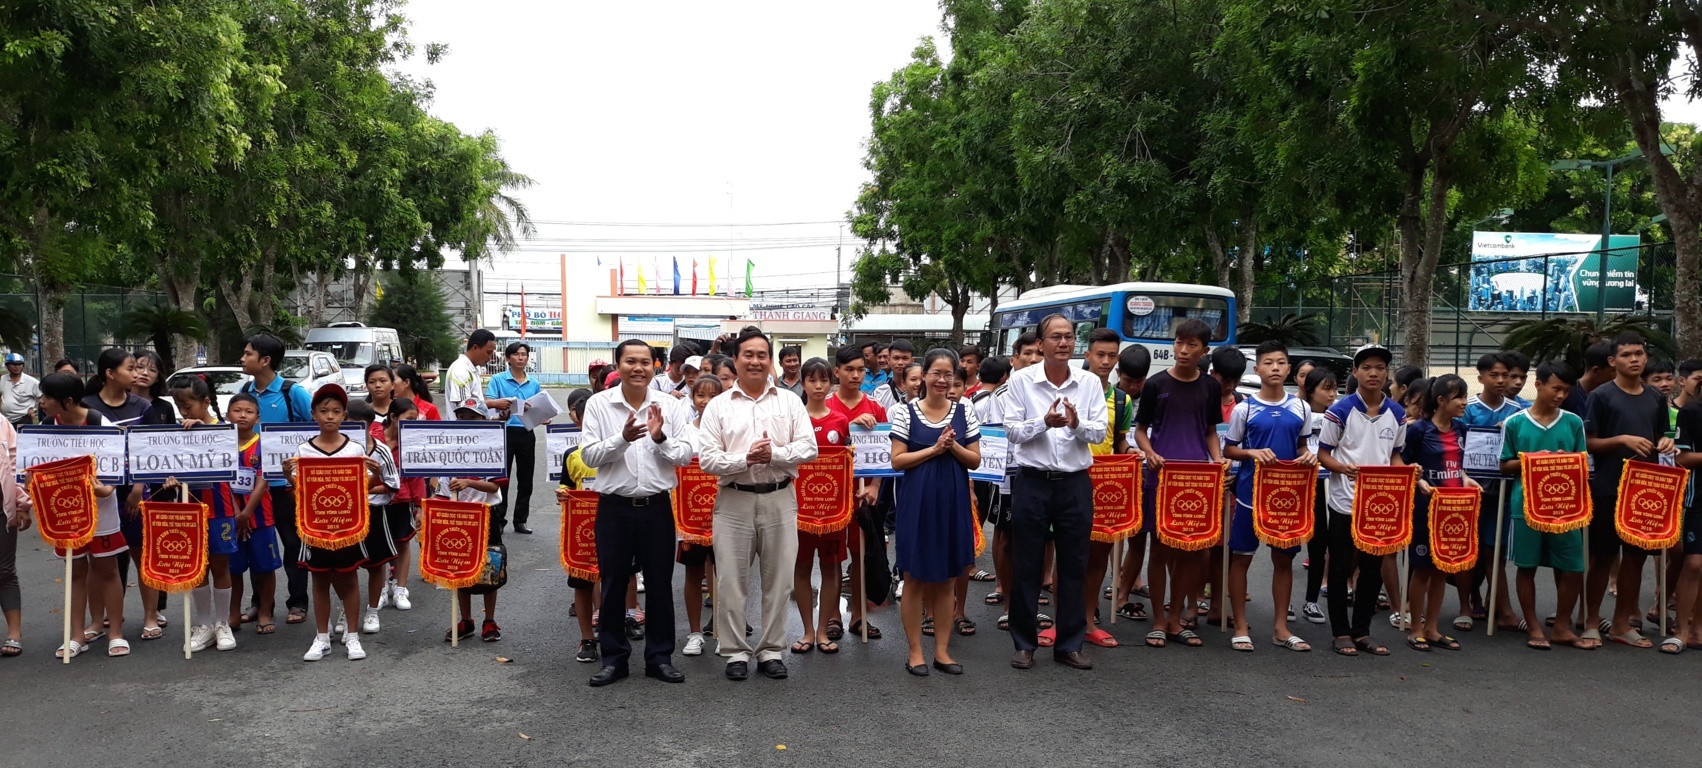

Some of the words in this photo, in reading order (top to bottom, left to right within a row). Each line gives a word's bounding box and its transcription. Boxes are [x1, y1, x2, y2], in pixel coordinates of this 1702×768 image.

[1580, 269, 1600, 277] Chun
[534, 310, 547, 318] BÒ
[793, 311, 826, 320] GIANG
[1154, 349, 1176, 359] 64B-
[37, 436, 69, 448] TRƯỜNG
[90, 438, 106, 449] HỌC
[148, 434, 180, 446] TRƯỜNG
[201, 434, 218, 446] HỌC
[456, 435, 479, 446] HỌC
[869, 435, 888, 444] THCS
[136, 453, 183, 470] LOAN
[188, 449, 216, 468] MỸ
[222, 452, 233, 467] B
[406, 447, 438, 463] TRẦN
[439, 446, 471, 464] QUỐC
[473, 447, 503, 463] TOẢN
[112, 457, 119, 472] B
[1446, 460, 1457, 468] Fly
[1429, 468, 1462, 480] Emirat
[231, 476, 252, 487] 33
[221, 523, 231, 540] 2
